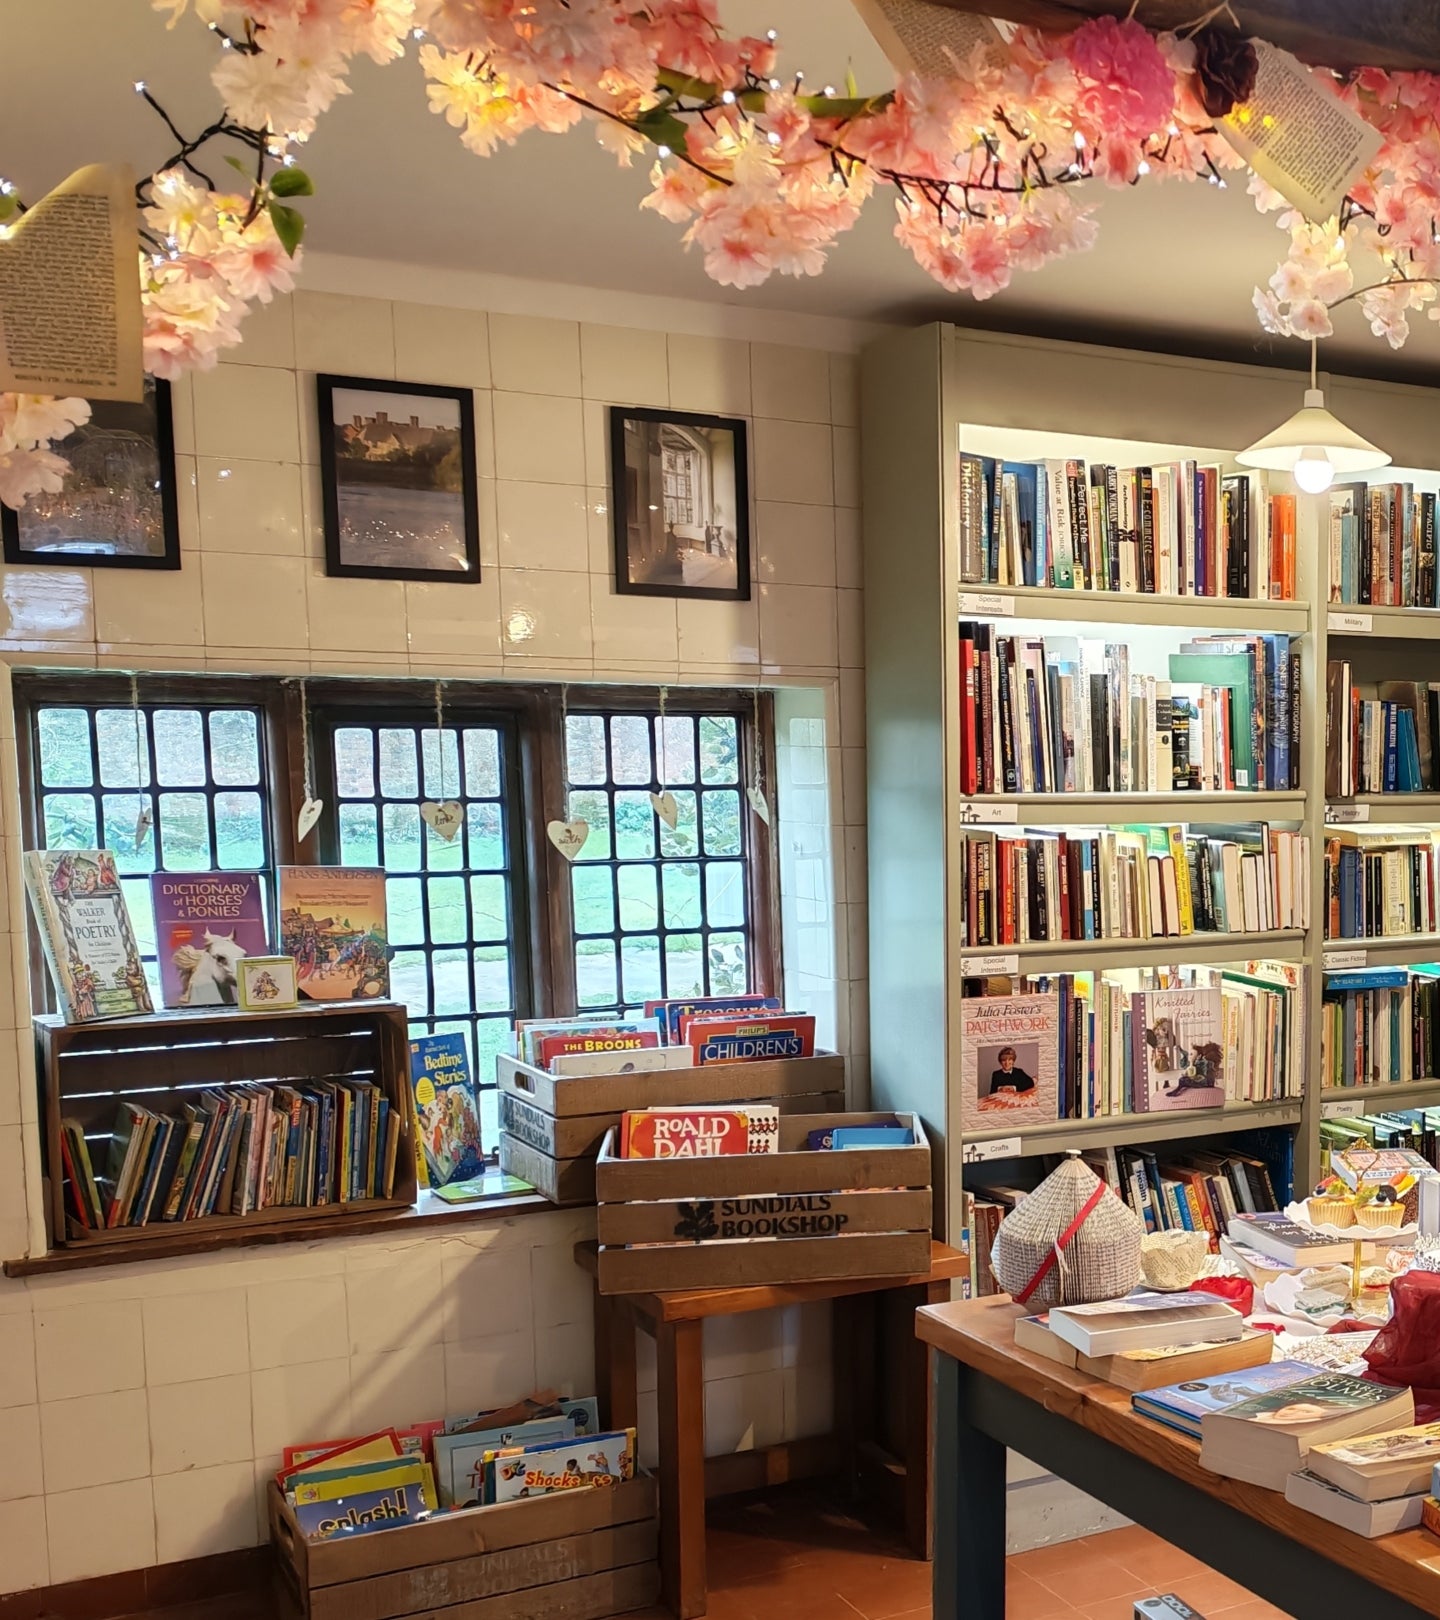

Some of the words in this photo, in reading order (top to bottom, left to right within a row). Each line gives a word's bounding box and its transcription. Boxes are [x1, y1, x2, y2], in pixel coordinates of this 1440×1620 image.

[1054, 470, 1064, 495] Value
[1108, 468, 1117, 493] BARRY
[1056, 496, 1062, 505] at
[1077, 484, 1087, 525] Perfect
[1109, 493, 1118, 522] NORMAN
[1122, 485, 1130, 529] Archaeology
[1056, 509, 1066, 528] Risk
[1080, 527, 1088, 543] Me
[1426, 512, 1434, 550] PACIFIC
[1279, 689, 1287, 700] by
[1279, 701, 1288, 731] himself
[1292, 693, 1300, 743] PHOTOGRAPHY
[992, 809, 1002, 817] Art
[288, 869, 320, 880] HANS
[321, 869, 378, 880] ANDERSEN
[162, 883, 250, 896] DICTIONARY
[979, 892, 985, 900] TO
[173, 897, 183, 907] of
[185, 895, 243, 906] HORSES
[76, 907, 107, 918] WALKER
[178, 909, 185, 918] &
[187, 905, 240, 918] PONIES
[74, 925, 119, 940] POETRY
[1154, 994, 1196, 1009] Knitted
[975, 1005, 1000, 1018] Julia
[1003, 1004, 1042, 1016] Foster's
[1175, 1008, 1213, 1021] Fairies
[966, 1016, 1051, 1034] PATCHWORK
[564, 1042, 583, 1052] THE
[584, 1038, 642, 1051] BROONS
[704, 1038, 800, 1060] CHILDREN'S
[424, 1052, 464, 1071] Bedtime
[434, 1068, 467, 1087] Stories
[653, 1116, 731, 1139] ROALD
[653, 1137, 730, 1158] DAHL
[990, 1145, 1009, 1153] Crafts
[721, 1194, 833, 1217] SUNDIALS
[720, 1214, 850, 1238] BOOKSHOP
[523, 1470, 581, 1488] Shocks
